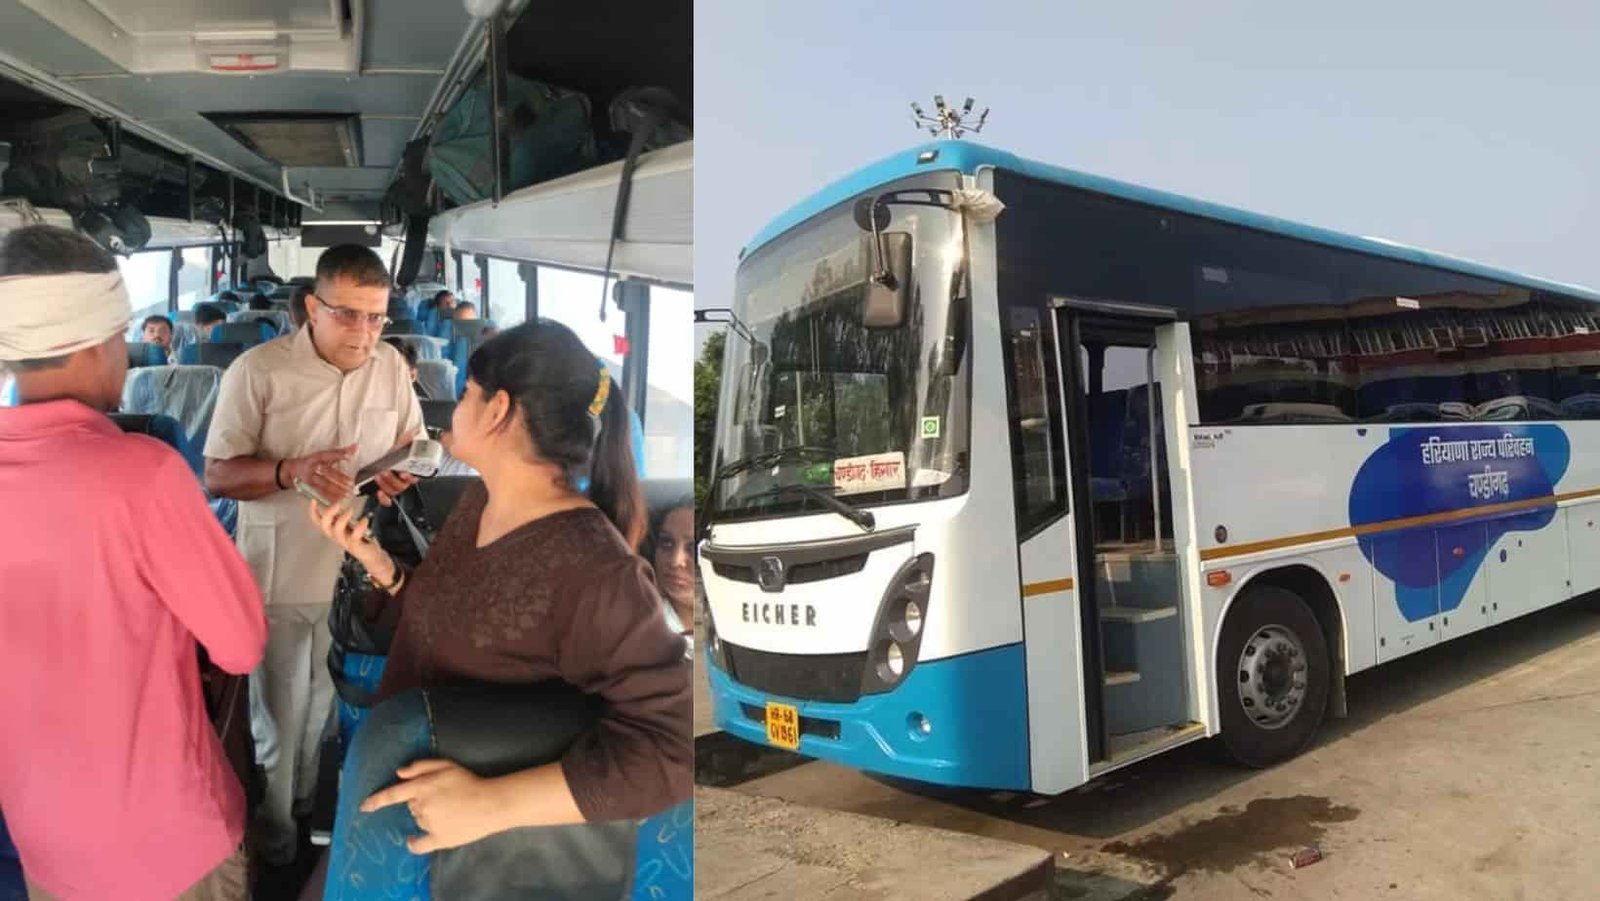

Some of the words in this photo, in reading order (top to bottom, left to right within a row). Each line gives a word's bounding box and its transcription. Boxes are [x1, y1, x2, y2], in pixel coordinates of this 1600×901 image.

[1420, 436, 1469, 464] हरियाणा
[1470, 439, 1497, 460] राज्य
[1497, 433, 1535, 458] परिवहन
[742, 602, 816, 627] EICHER
